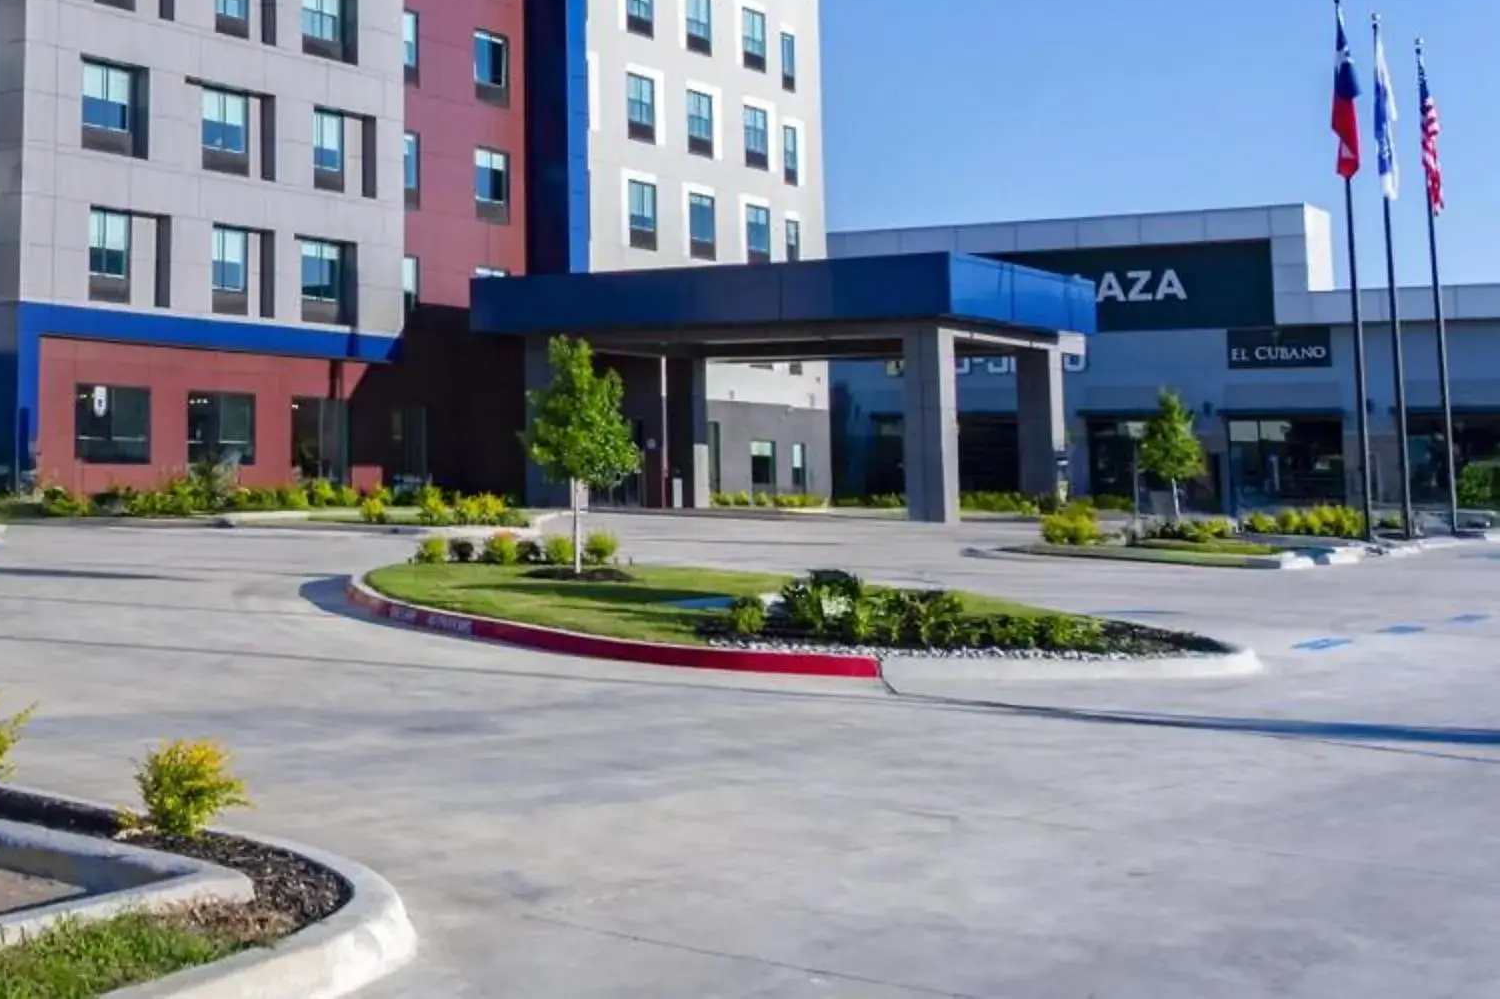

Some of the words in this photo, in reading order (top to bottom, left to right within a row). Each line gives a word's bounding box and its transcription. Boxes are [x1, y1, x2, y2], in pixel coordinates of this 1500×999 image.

[1095, 268, 1188, 302] AZA
[1231, 347, 1250, 361] EL
[1254, 346, 1327, 361] CUBANO
